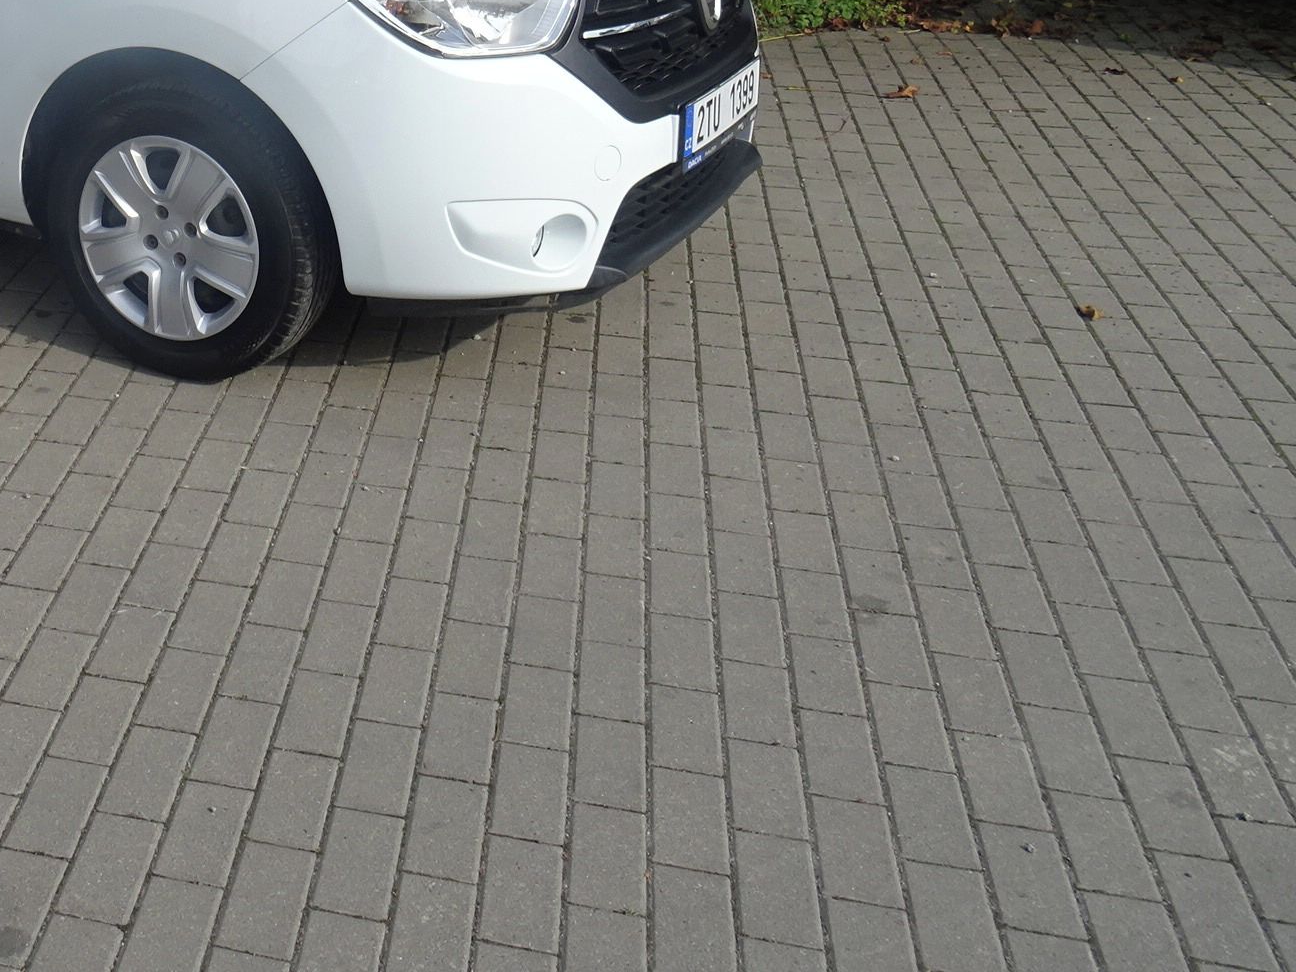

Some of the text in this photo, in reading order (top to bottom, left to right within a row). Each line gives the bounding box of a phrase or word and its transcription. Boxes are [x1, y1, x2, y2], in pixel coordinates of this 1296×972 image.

[696, 70, 755, 145] 2TU 1399
[684, 137, 693, 152] CZ
